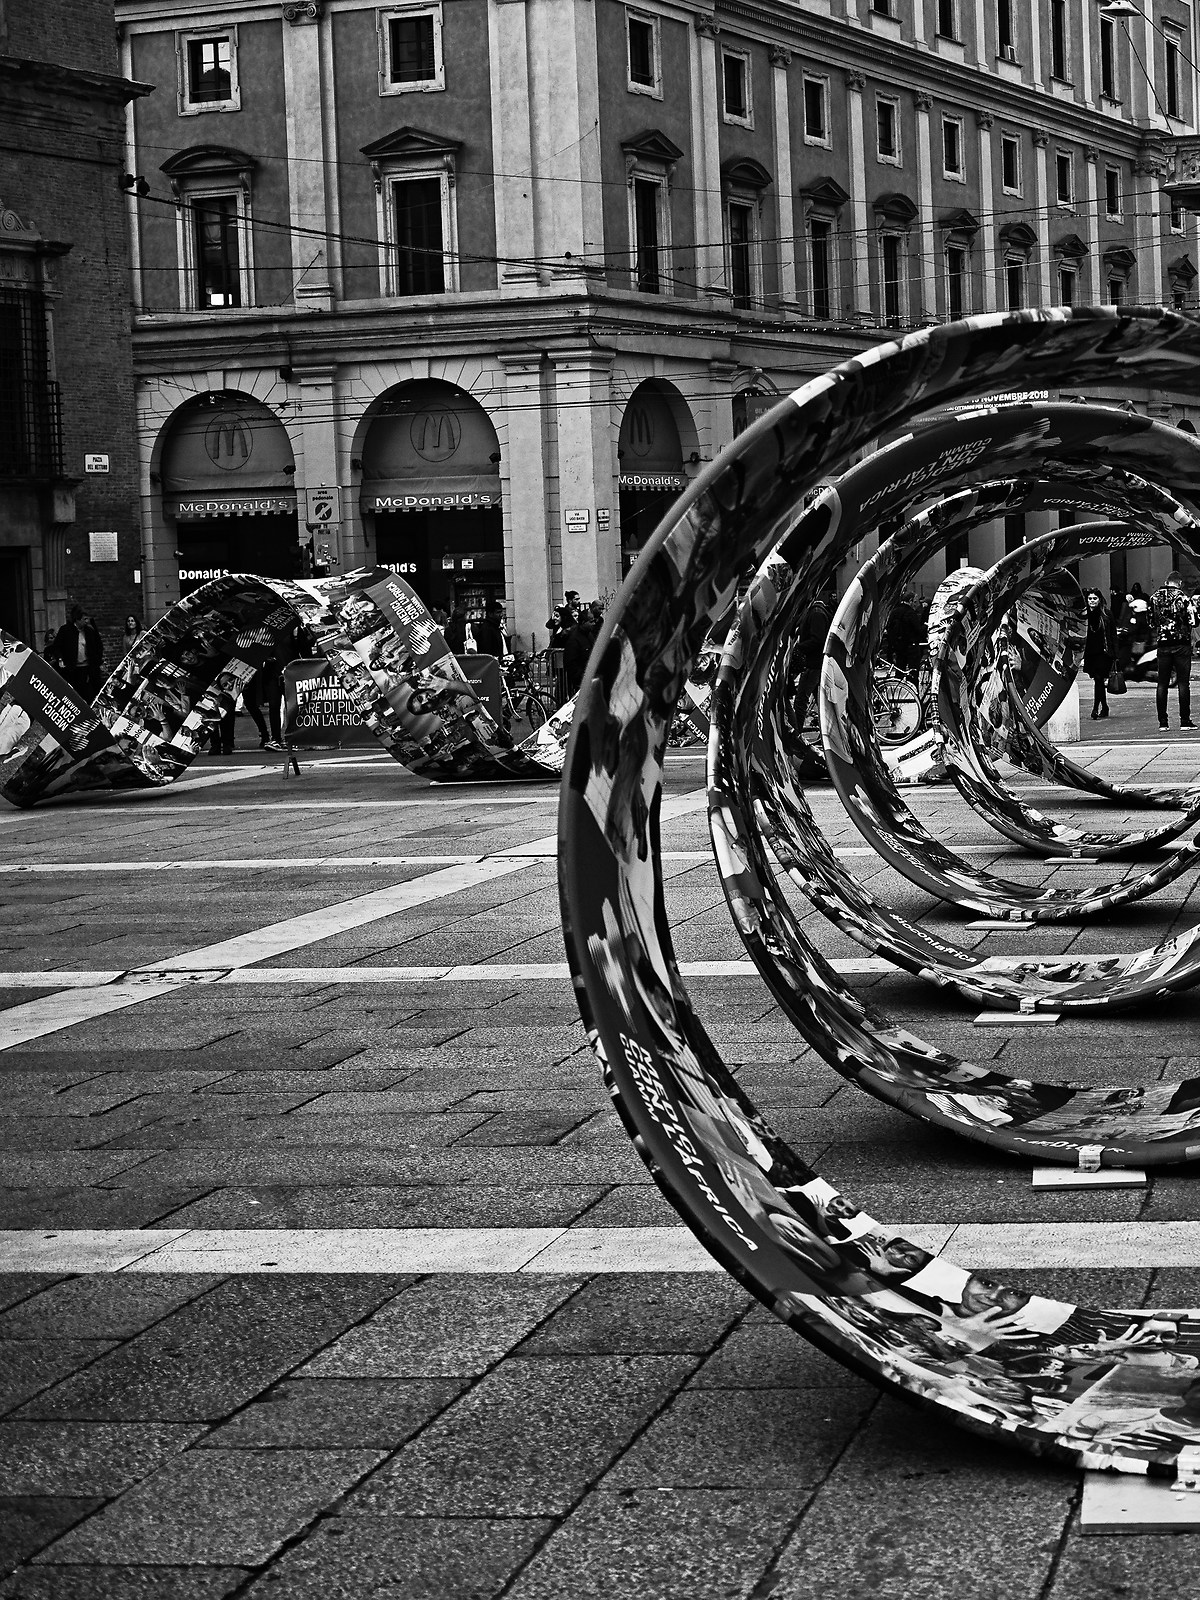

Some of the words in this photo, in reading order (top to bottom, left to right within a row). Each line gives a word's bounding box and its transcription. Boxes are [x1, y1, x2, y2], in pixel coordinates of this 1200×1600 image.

[1028, 390, 1049, 400] 2018
[619, 475, 681, 487] McDonald's
[179, 500, 288, 512] McDonald's
[375, 493, 491, 507] McDonald's
[389, 600, 412, 626] MEDICI
[404, 604, 420, 621] CON
[29, 674, 61, 707] L'AFRICA
[295, 677, 328, 694] PRIMA
[328, 675, 341, 688] LE
[61, 695, 81, 716] CUAMM
[296, 693, 304, 705] E
[311, 688, 350, 701] BAMBIN
[1031, 681, 1054, 715] L'AFRICA
[42, 702, 69, 732] MEDICI
[59, 705, 76, 724] CON
[323, 701, 335, 714] DI
[295, 714, 319, 727] CON
[619, 1032, 660, 1123] CUAMM
[640, 1046, 705, 1167] MEDICI
[628, 1038, 665, 1112] CON
[661, 1121, 759, 1252] L'AFRICA
